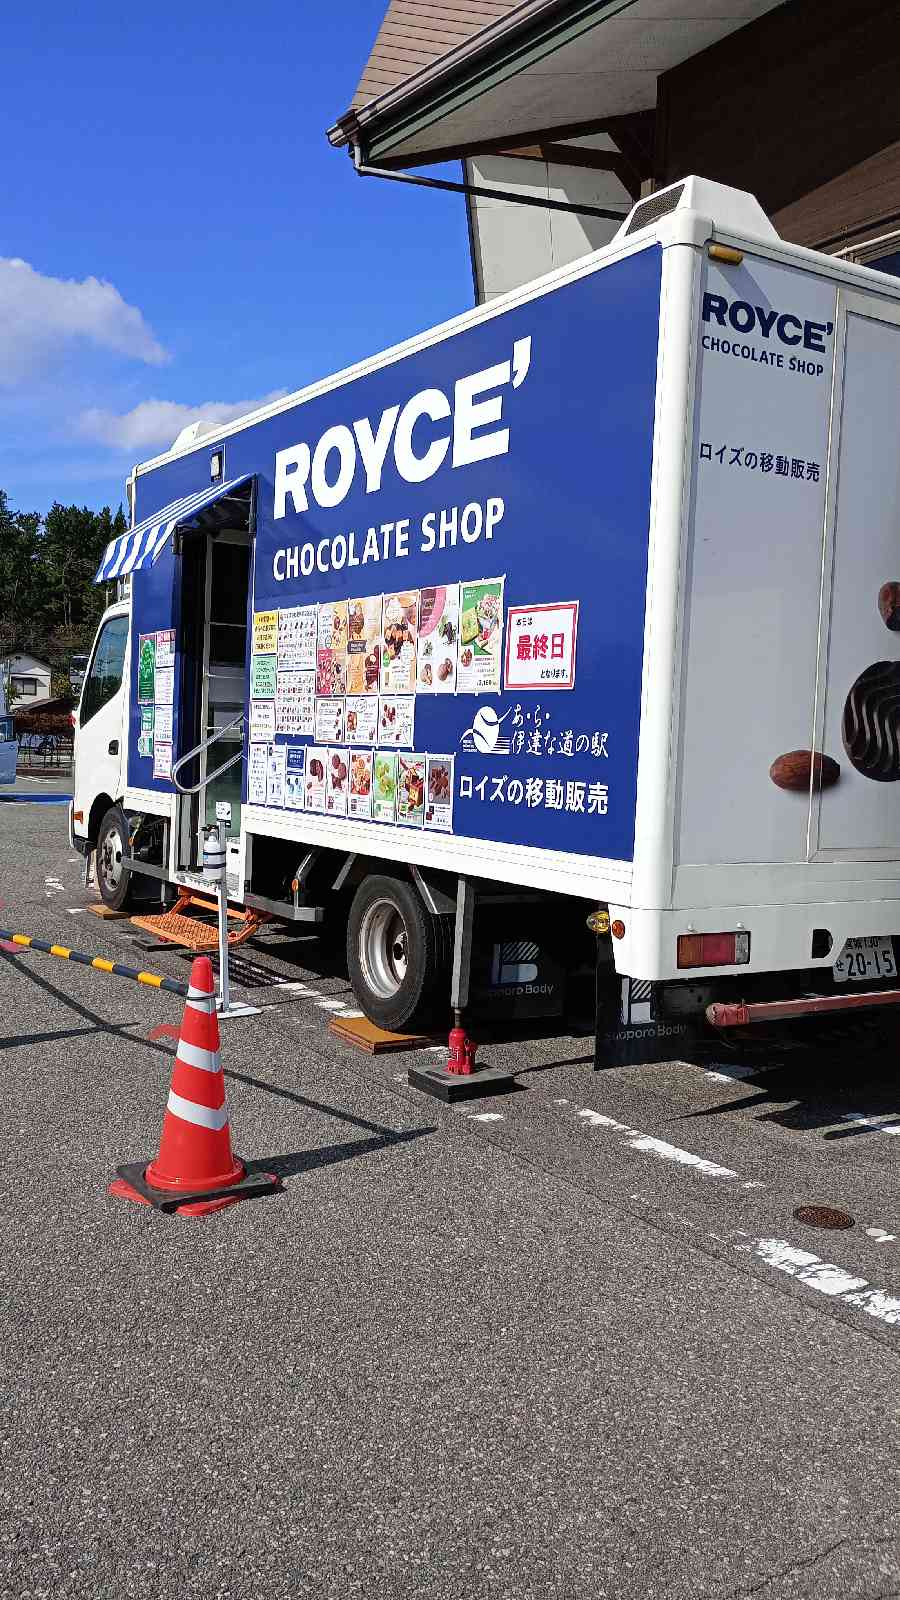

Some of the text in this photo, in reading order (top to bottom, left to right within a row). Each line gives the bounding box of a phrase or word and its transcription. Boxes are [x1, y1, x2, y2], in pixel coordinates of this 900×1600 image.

[701, 291, 834, 354] ROYCE'
[701, 335, 824, 377] CHOCOLATE SHOP
[273, 335, 532, 520] ROYCE'
[700, 441, 821, 482] ロイズの移動販売
[272, 497, 505, 582] CHOCOLATE SHOP
[516, 632, 565, 661] 最終日
[511, 729, 609, 758] 伊達な道の駅
[459, 774, 609, 815] ロイズの移動販売
[845, 950, 894, 977] 20-15
